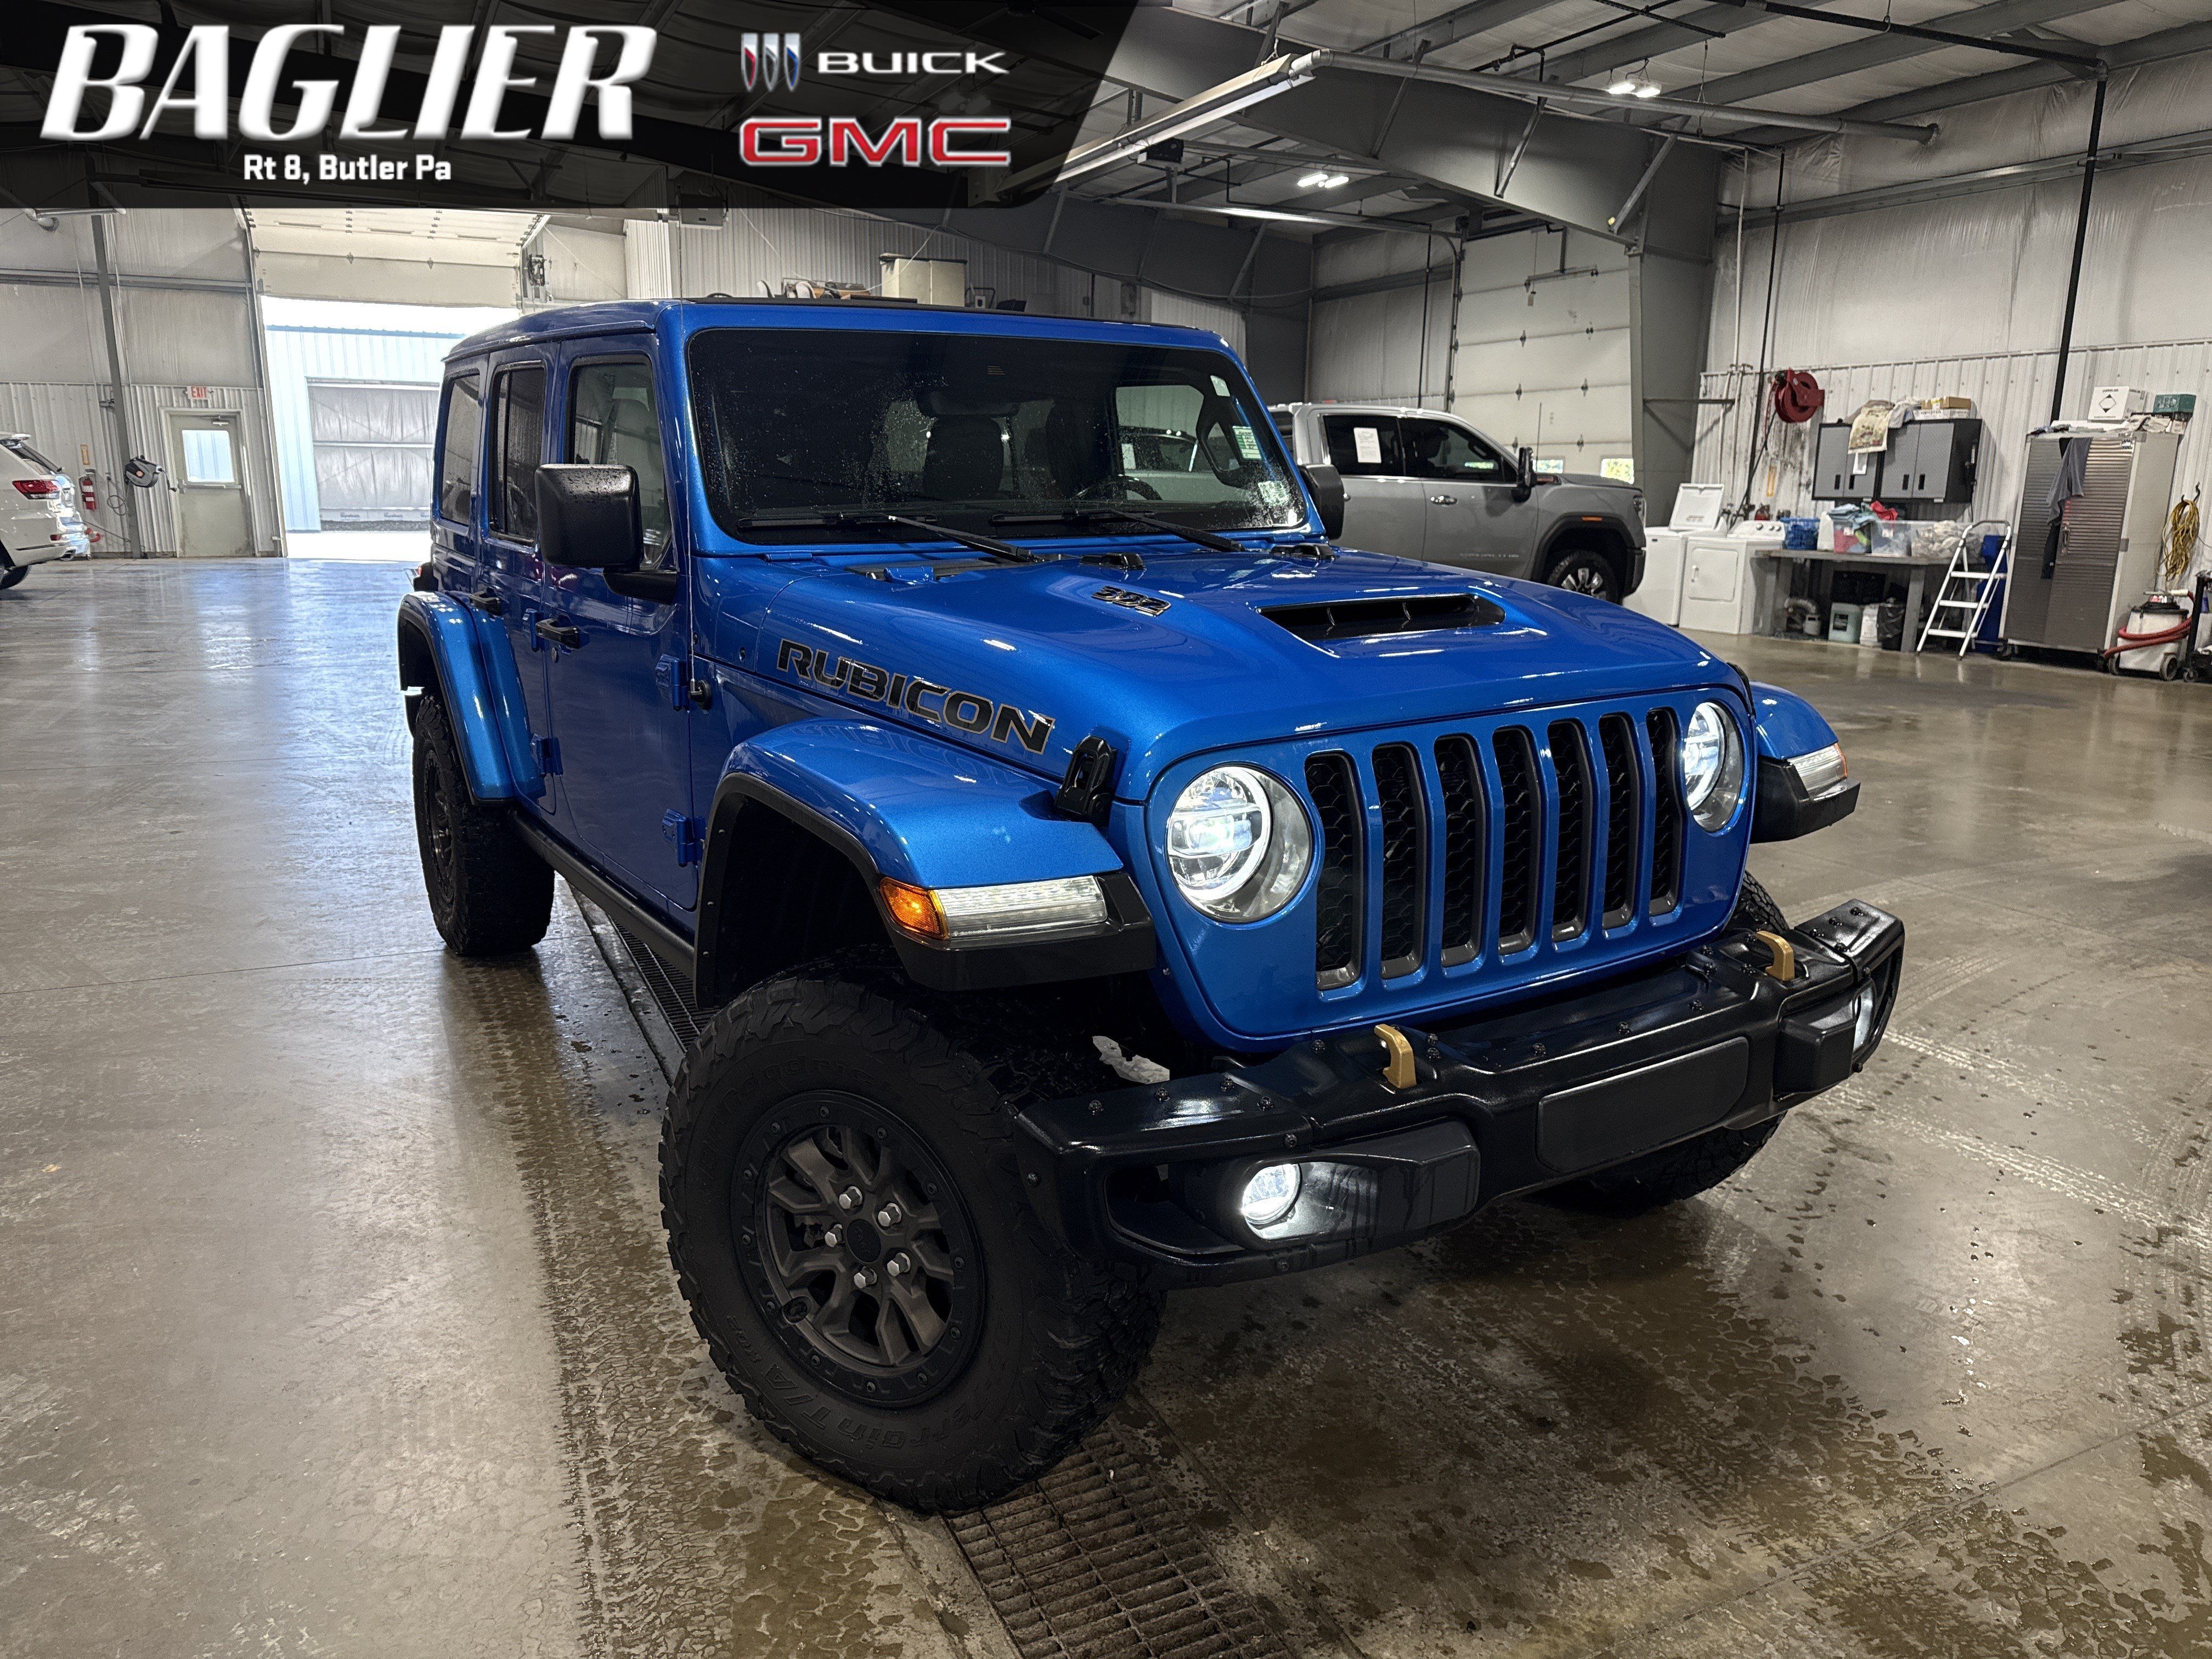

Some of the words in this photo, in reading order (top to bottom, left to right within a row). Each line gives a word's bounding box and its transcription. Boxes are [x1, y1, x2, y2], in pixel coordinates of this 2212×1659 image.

[190, 386, 207, 398] EXIT
[1091, 585, 1172, 617] 392
[776, 638, 1056, 755] RUBICON
